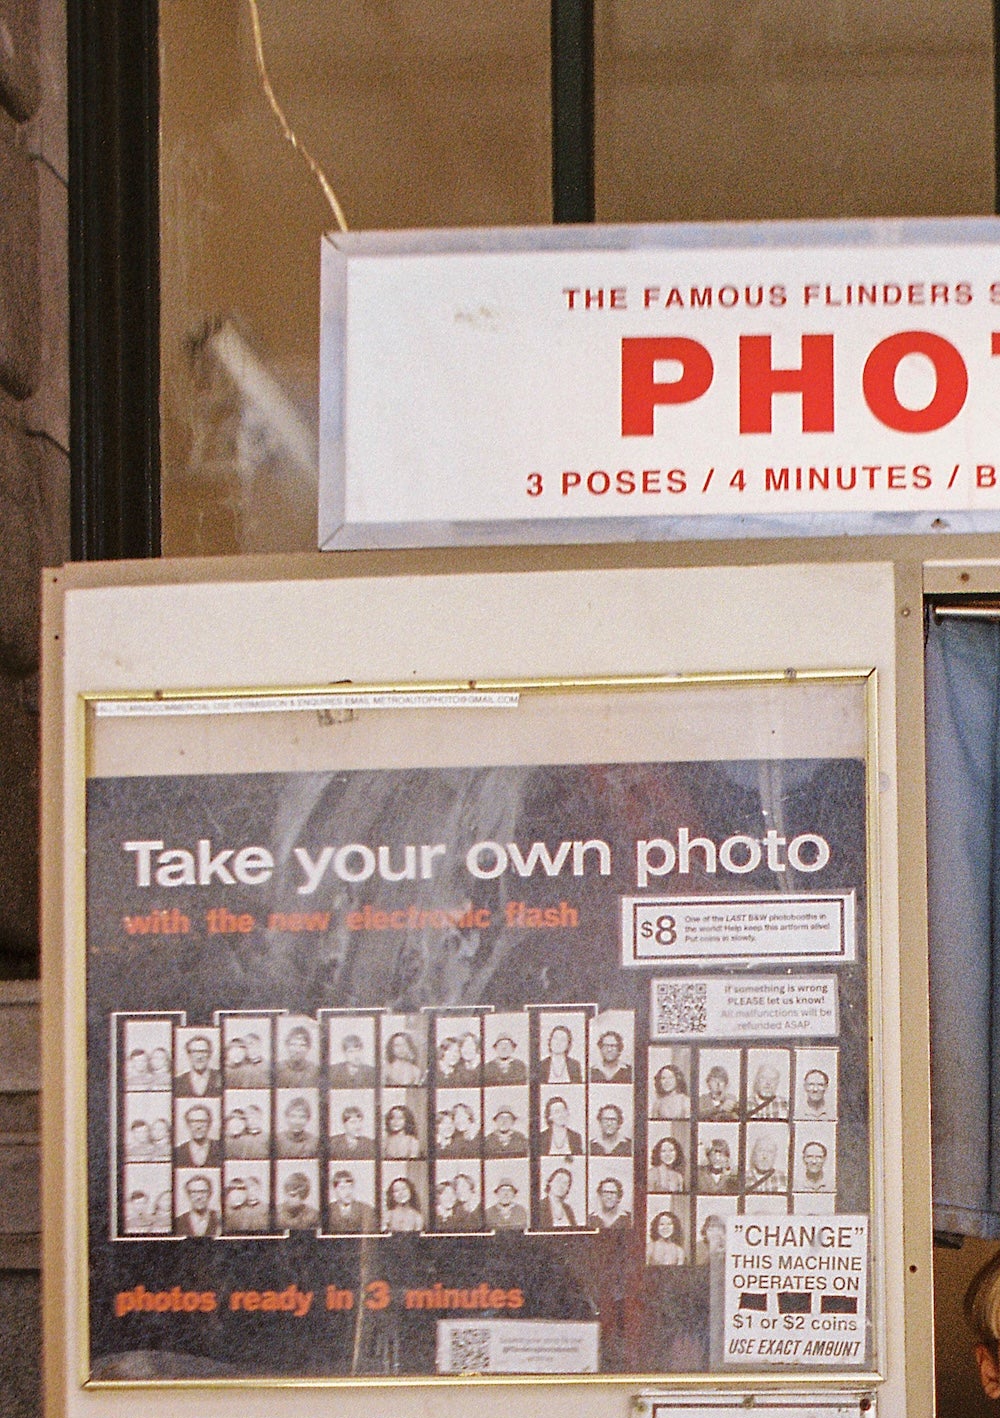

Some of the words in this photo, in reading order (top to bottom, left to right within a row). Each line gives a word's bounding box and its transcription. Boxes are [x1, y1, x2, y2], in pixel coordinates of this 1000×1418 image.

[564, 287, 627, 310] THE
[644, 285, 787, 308] FAMOUS
[804, 283, 973, 306] FLINDERS
[527, 473, 543, 497] 3
[562, 469, 688, 496] POSES
[729, 467, 747, 492] 4
[765, 465, 933, 491] MINUTES
[124, 840, 274, 887] Take
[296, 842, 445, 894] your
[466, 843, 611, 878] own
[637, 828, 830, 887] photo
[124, 909, 189, 935] with
[206, 908, 254, 933] the
[269, 911, 330, 931] new
[505, 902, 577, 928] flash
[726, 913, 747, 922] LAST
[641, 915, 677, 946] $8
[744, 923, 763, 933] keep
[764, 923, 778, 931] this
[734, 985, 785, 995] something
[787, 984, 795, 993] is
[798, 985, 828, 994] wrong
[728, 997, 765, 1006] PLEASE
[767, 997, 780, 1006] let
[796, 996, 825, 1005] know!
[820, 1008, 832, 1017] be
[732, 1254, 772, 1271] THIS
[779, 1254, 862, 1271] MACHINE
[733, 1275, 827, 1290] OPERATES
[834, 1275, 860, 1290] ON
[115, 1285, 216, 1316] photos
[230, 1284, 313, 1316] ready
[325, 1284, 353, 1310] in
[365, 1280, 391, 1309] 3
[406, 1283, 523, 1309] minutes
[733, 1314, 752, 1330] $1
[760, 1317, 779, 1330] or
[783, 1314, 805, 1331] $2
[811, 1316, 858, 1331] coins
[729, 1338, 756, 1355] USE
[758, 1339, 802, 1356] EXACT
[803, 1341, 861, 1357] AMOUNT
